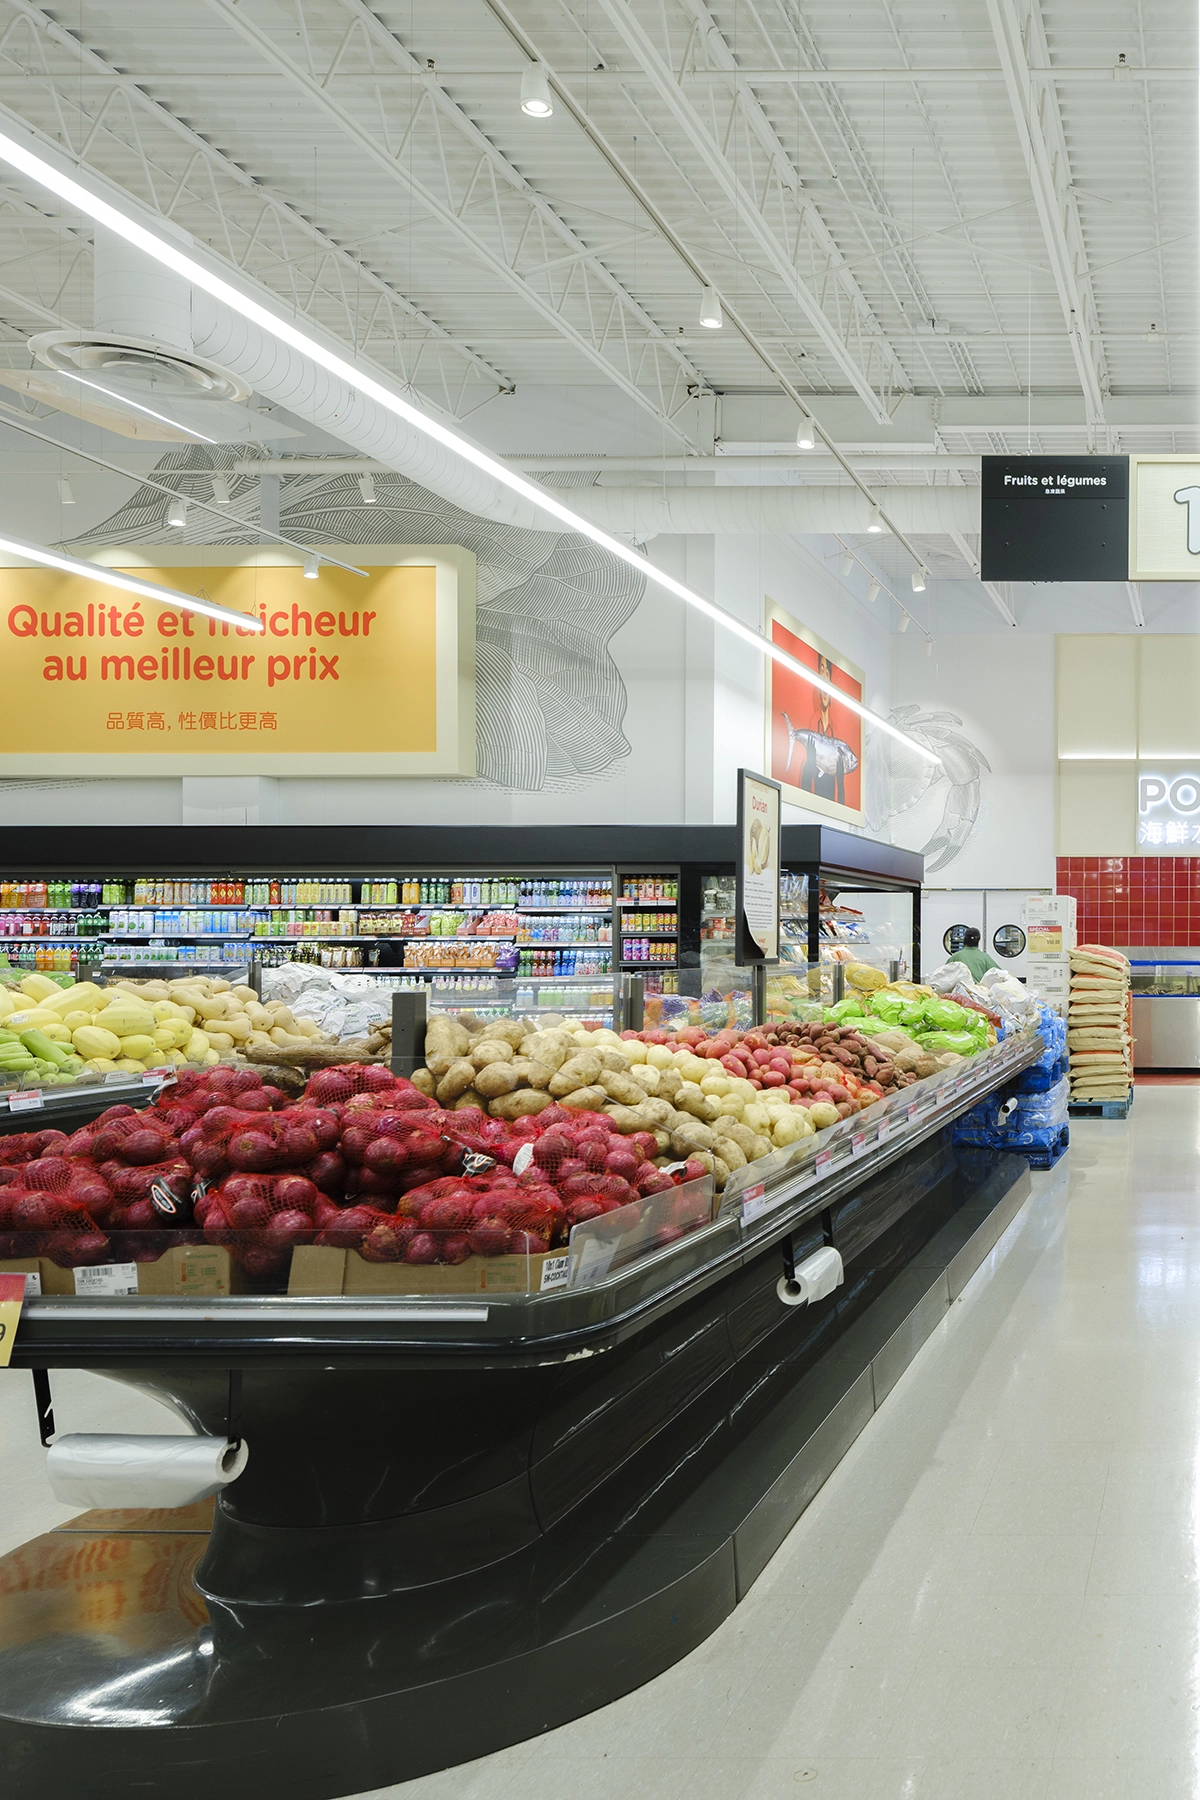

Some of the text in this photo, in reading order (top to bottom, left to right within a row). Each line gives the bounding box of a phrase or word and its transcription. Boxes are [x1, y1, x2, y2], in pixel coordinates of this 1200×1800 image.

[1003, 473, 1107, 489] Fruits et légumes
[7, 602, 145, 638] Qualité
[157, 609, 195, 638] et
[42, 647, 340, 688] au meilleur prix
[752, 795, 768, 814] Durian
